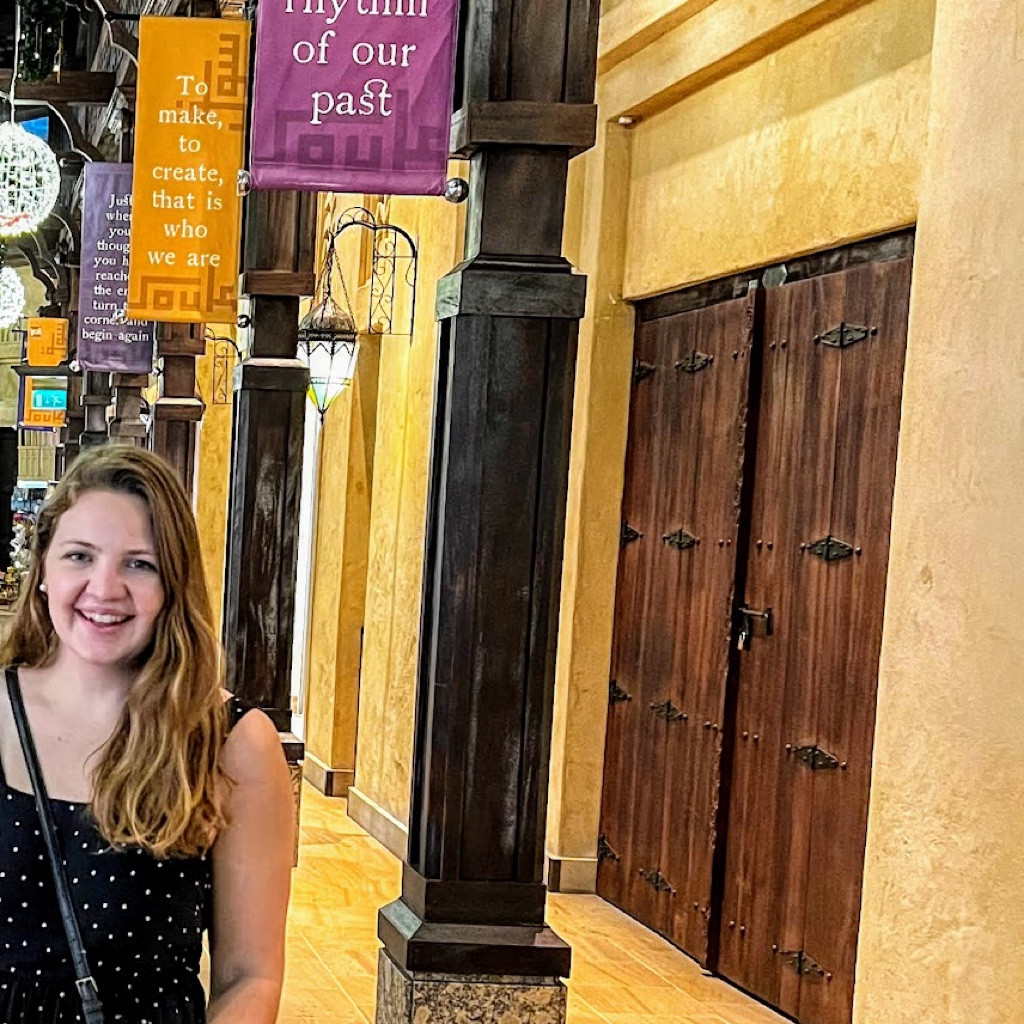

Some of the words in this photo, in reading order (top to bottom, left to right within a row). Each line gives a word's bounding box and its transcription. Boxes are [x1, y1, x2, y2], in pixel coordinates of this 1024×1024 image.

[292, 29, 336, 64] of
[352, 42, 417, 67] our
[176, 75, 208, 96] To
[310, 79, 392, 124] past
[159, 104, 223, 130] make,
[179, 135, 201, 153] to
[152, 164, 224, 187] create,
[152, 189, 195, 209] that
[207, 191, 223, 210] is
[108, 227, 130, 238] you
[164, 218, 208, 238] who
[96, 238, 130, 254] thoug
[93, 256, 116, 268] you
[148, 251, 176, 265] we
[187, 252, 220, 268] are
[95, 269, 129, 281] reach
[93, 283, 112, 296] the
[92, 299, 117, 311] turn
[84, 315, 120, 326] corne
[81, 327, 113, 343] begin
[118, 329, 149, 344] again
